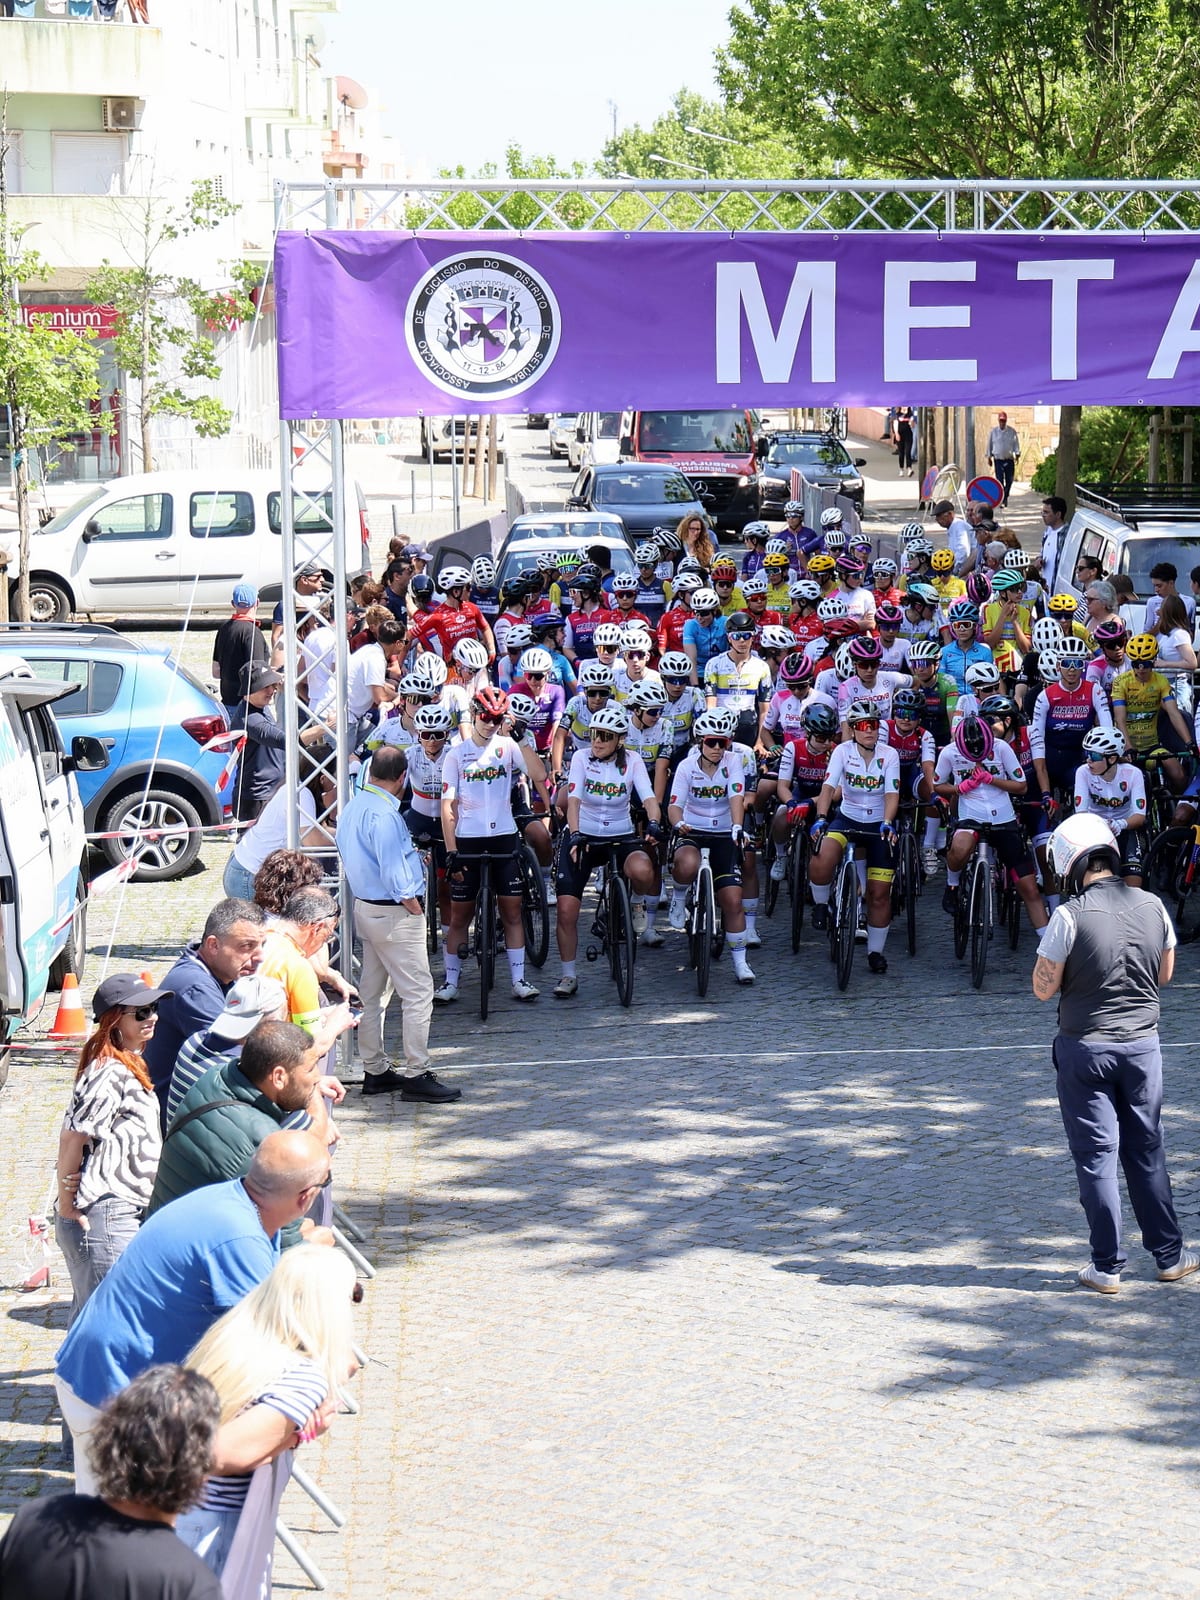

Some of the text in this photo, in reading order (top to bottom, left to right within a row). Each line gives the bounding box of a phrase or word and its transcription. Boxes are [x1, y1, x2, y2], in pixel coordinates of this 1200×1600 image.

[483, 259, 500, 269] DO
[424, 262, 467, 296] CICLISMO
[513, 270, 548, 310] DISTRITO
[414, 309, 425, 325] DE
[542, 325, 551, 339] DE
[418, 340, 471, 389] ASSOCIAÇÃO
